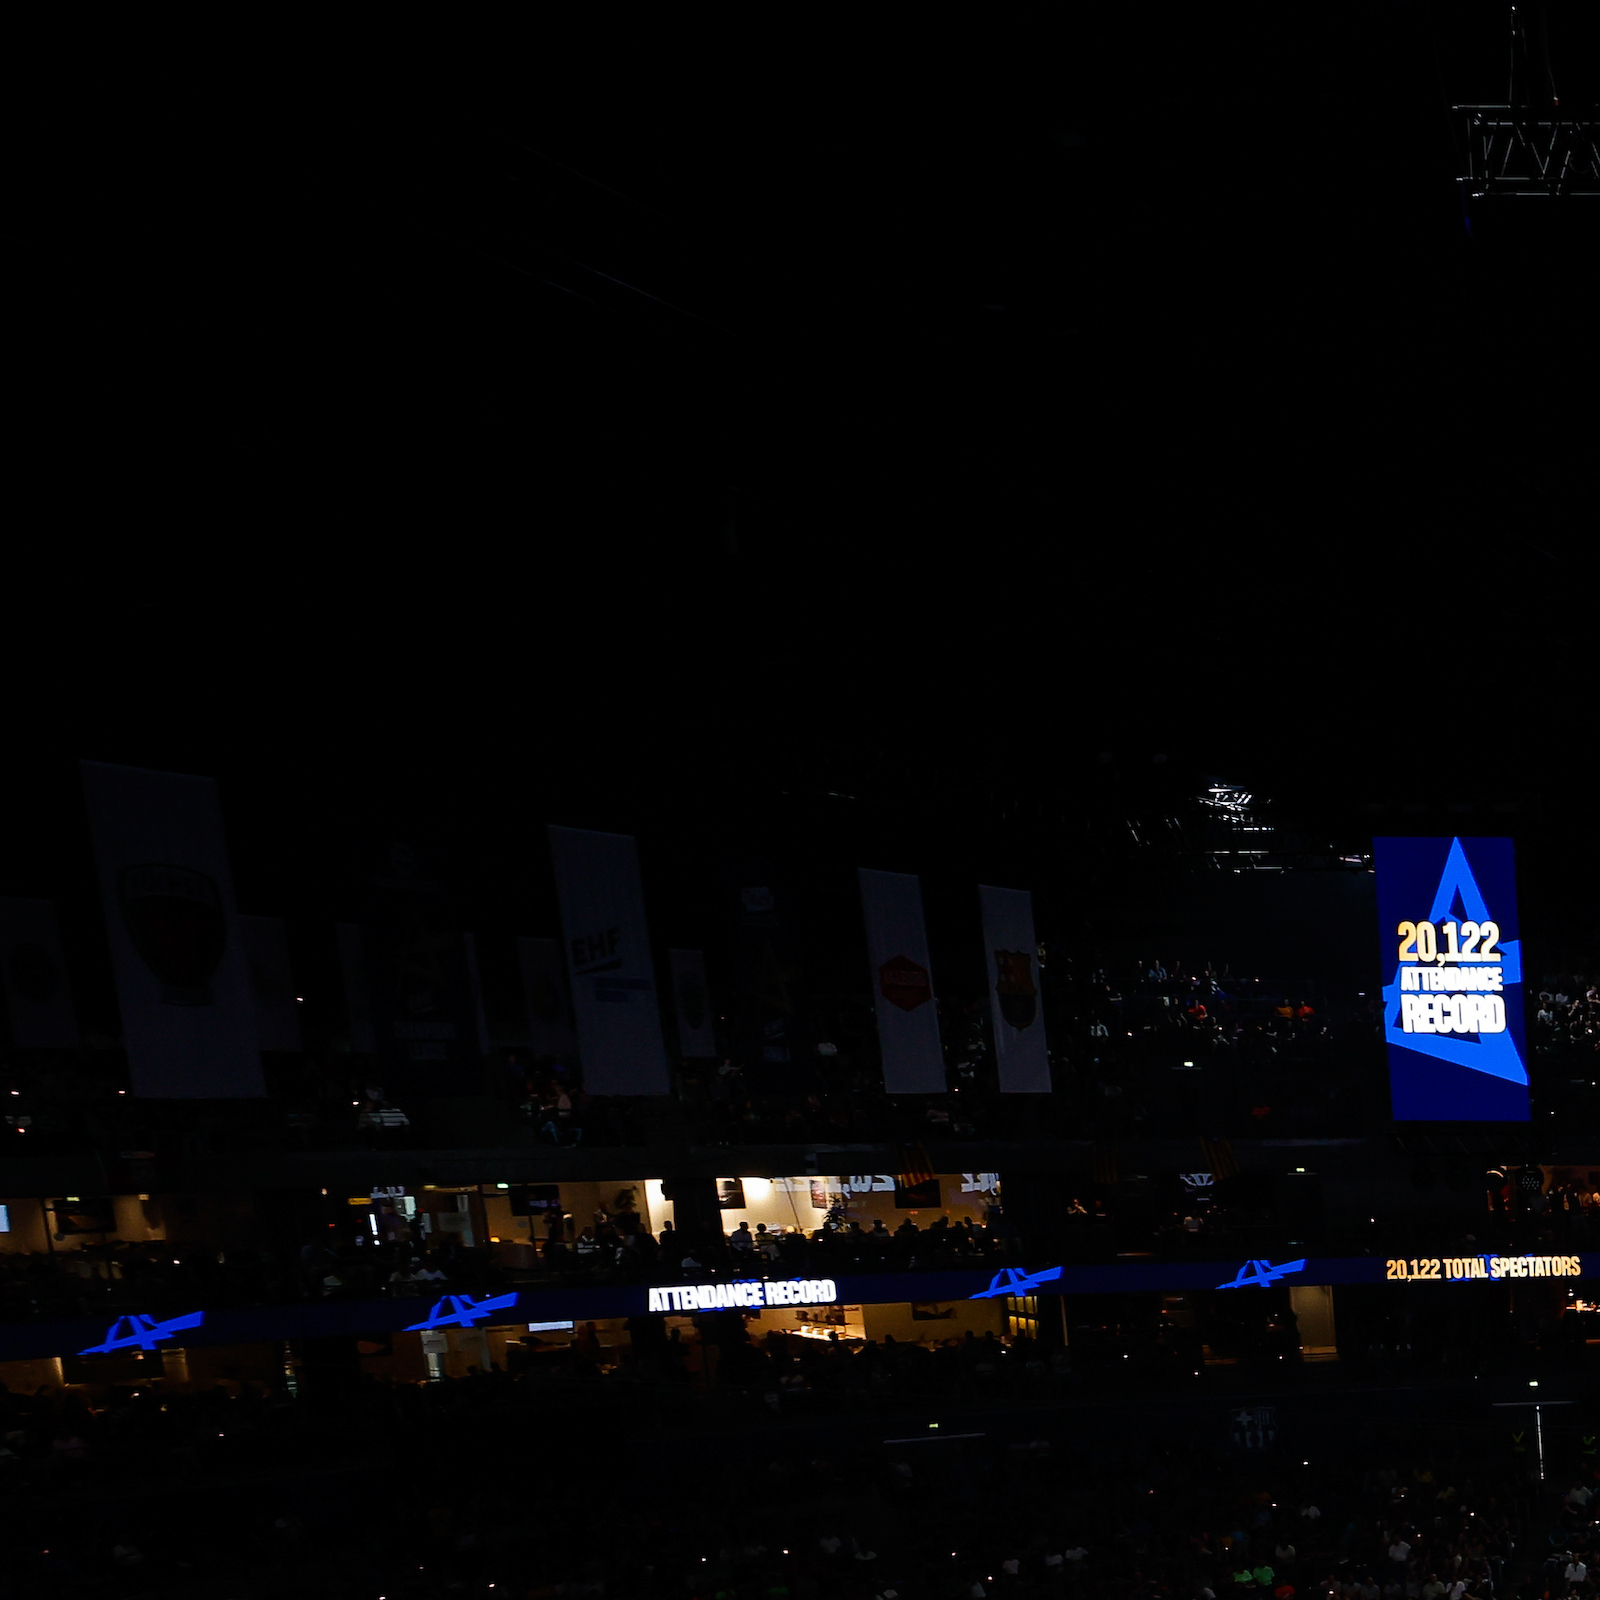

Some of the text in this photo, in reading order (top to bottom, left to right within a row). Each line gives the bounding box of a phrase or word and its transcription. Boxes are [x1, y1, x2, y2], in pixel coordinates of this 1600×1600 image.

[1398, 921, 1501, 966] 20,122
[1401, 967, 1503, 992] ATTENDANCE
[1400, 994, 1505, 1034] RECORD
[1386, 1256, 1580, 1282] 20,122 TOTAL SPECTATORS
[649, 1279, 837, 1312] ATTENDANCE RECORD
